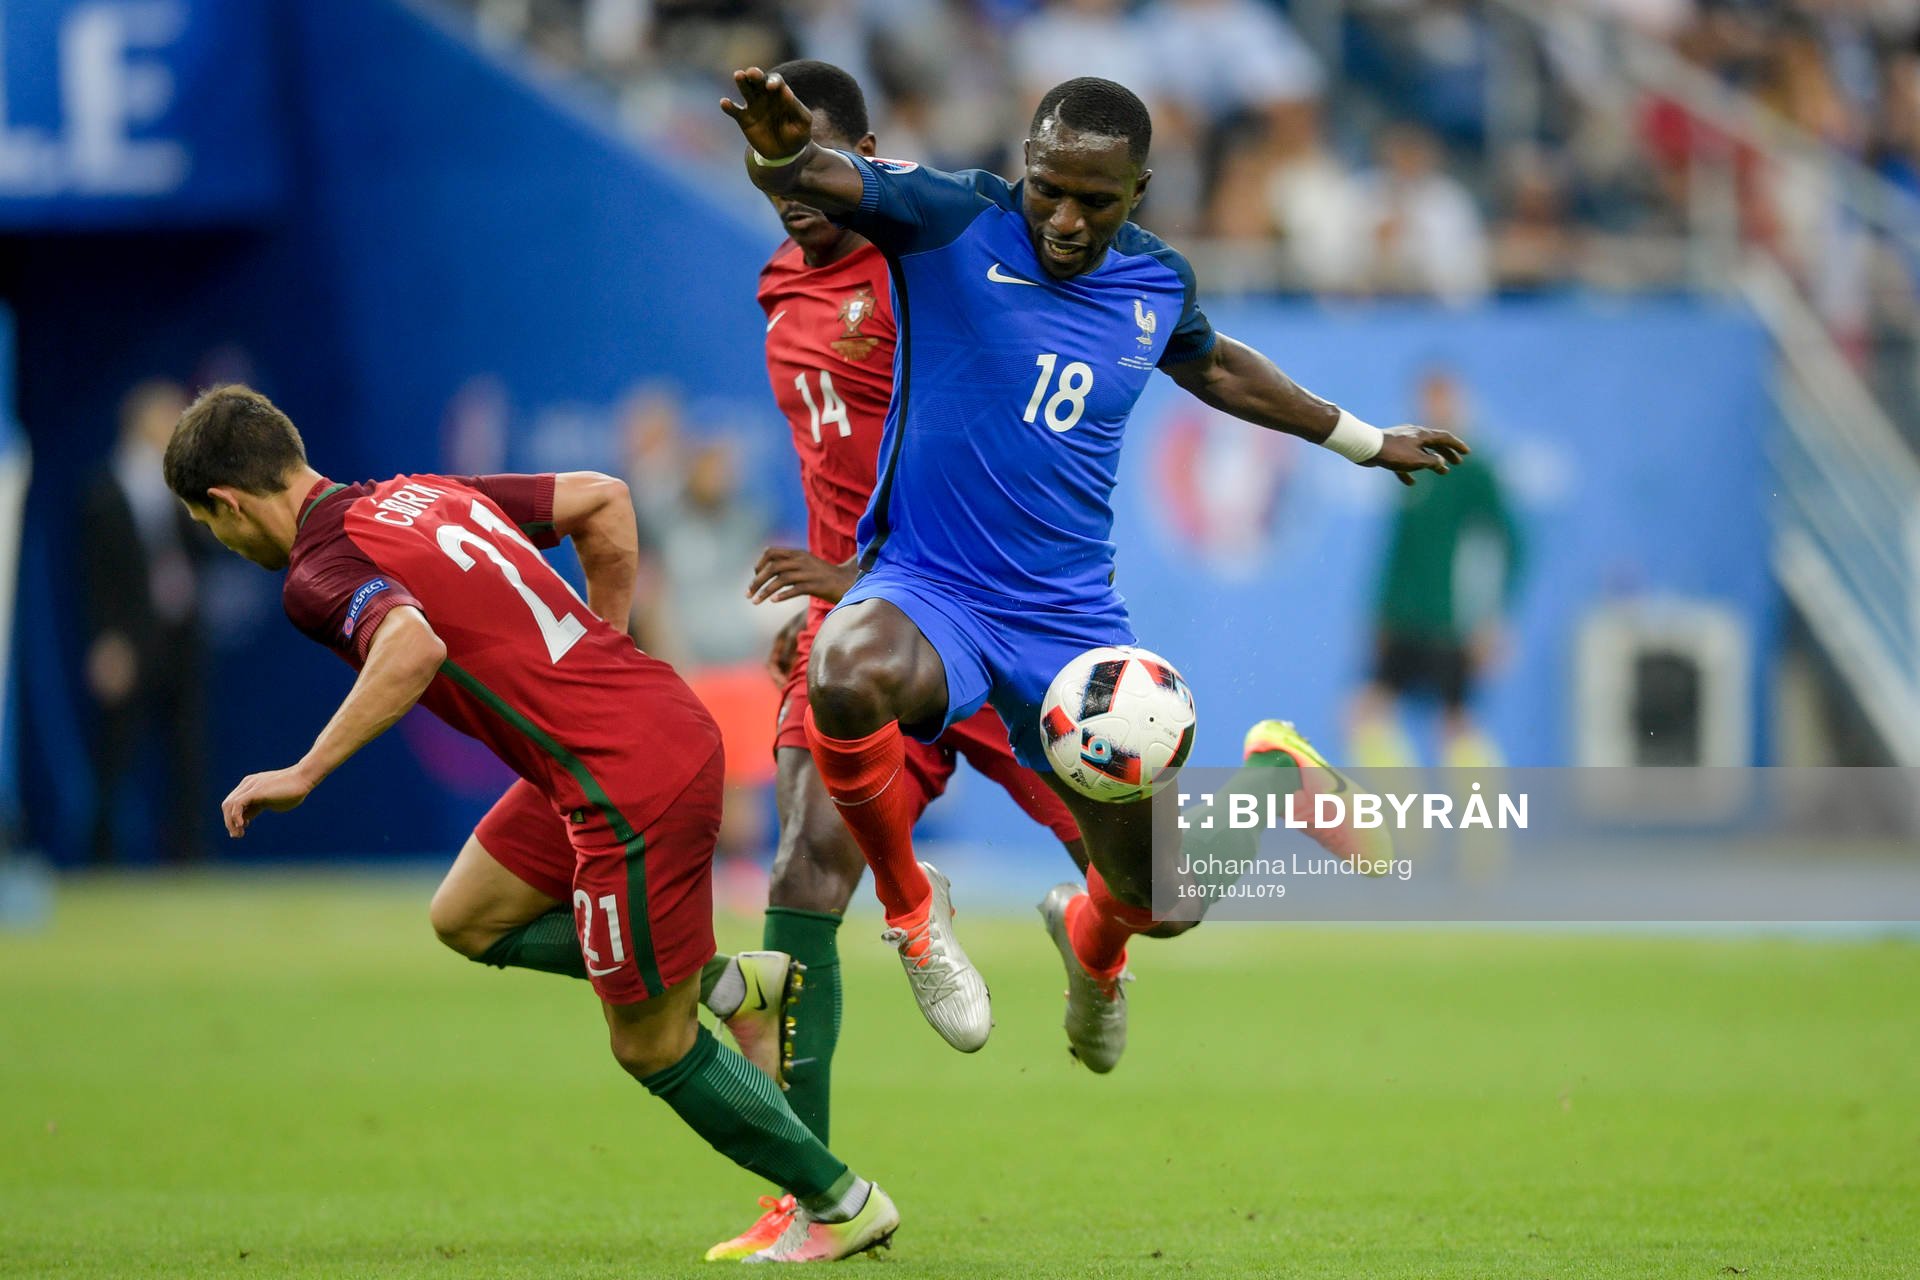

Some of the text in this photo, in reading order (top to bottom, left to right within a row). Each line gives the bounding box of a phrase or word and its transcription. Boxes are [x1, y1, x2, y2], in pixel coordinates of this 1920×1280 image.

[794, 370, 852, 443] 14
[1022, 353, 1094, 433] 18
[350, 579, 385, 619] RESPECT
[436, 499, 603, 665] 21
[573, 889, 625, 963] 21
